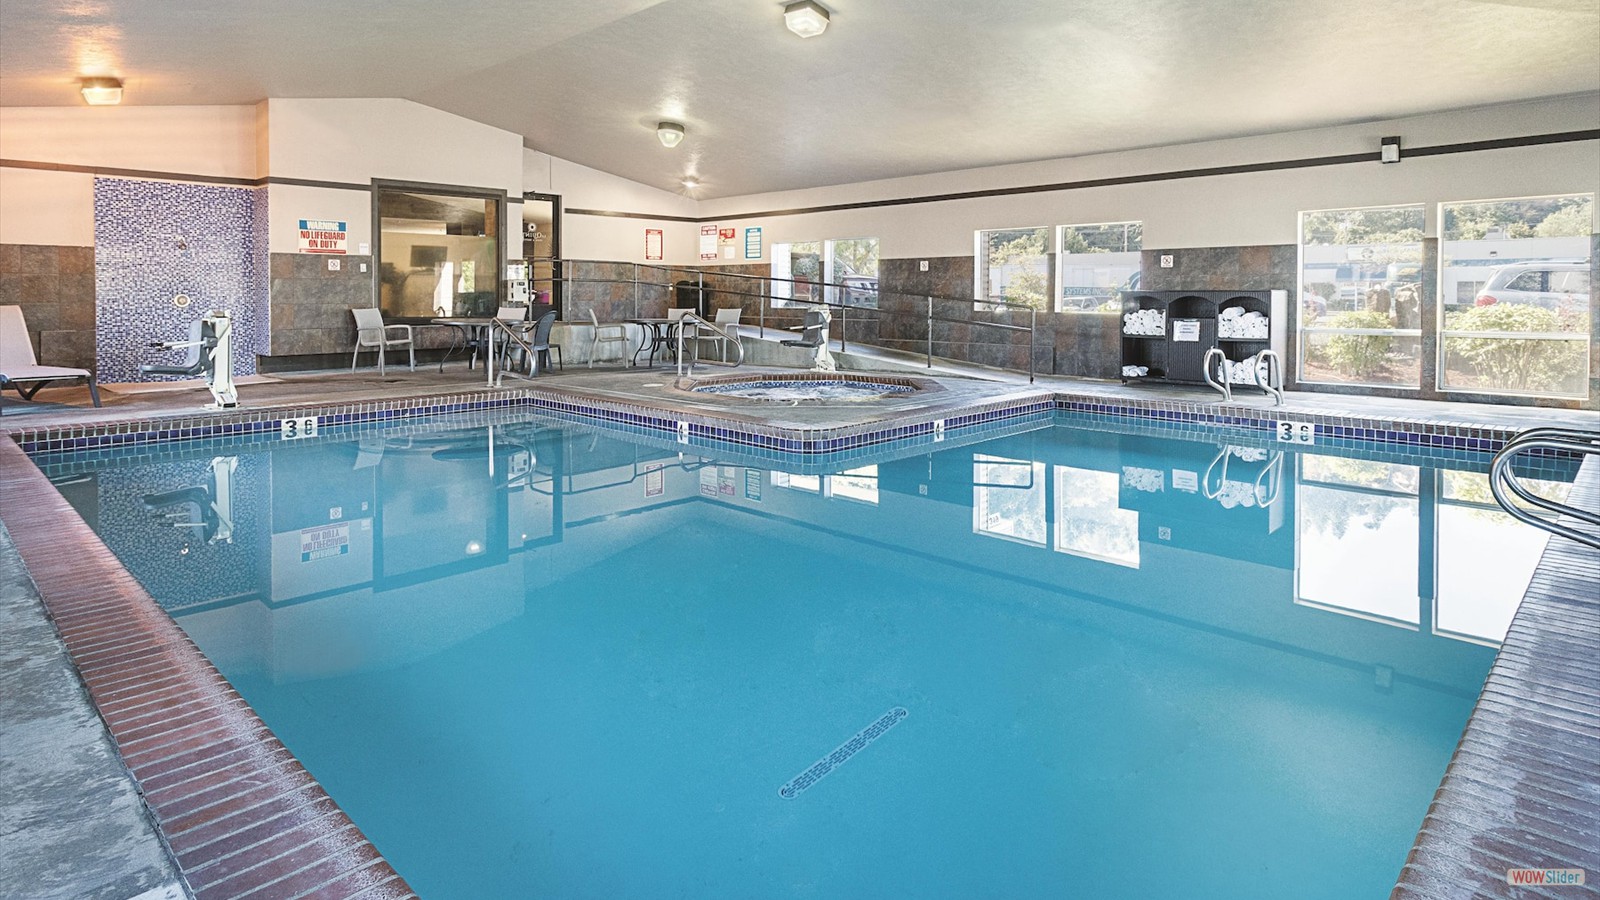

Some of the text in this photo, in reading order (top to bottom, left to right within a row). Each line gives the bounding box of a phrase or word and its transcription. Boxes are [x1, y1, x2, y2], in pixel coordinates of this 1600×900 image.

[306, 220, 340, 231] WARNING
[300, 230, 345, 240] NO LIFEGUARD
[309, 239, 337, 248] ON DUTY
[1065, 287, 1091, 296] SYSTEMS
